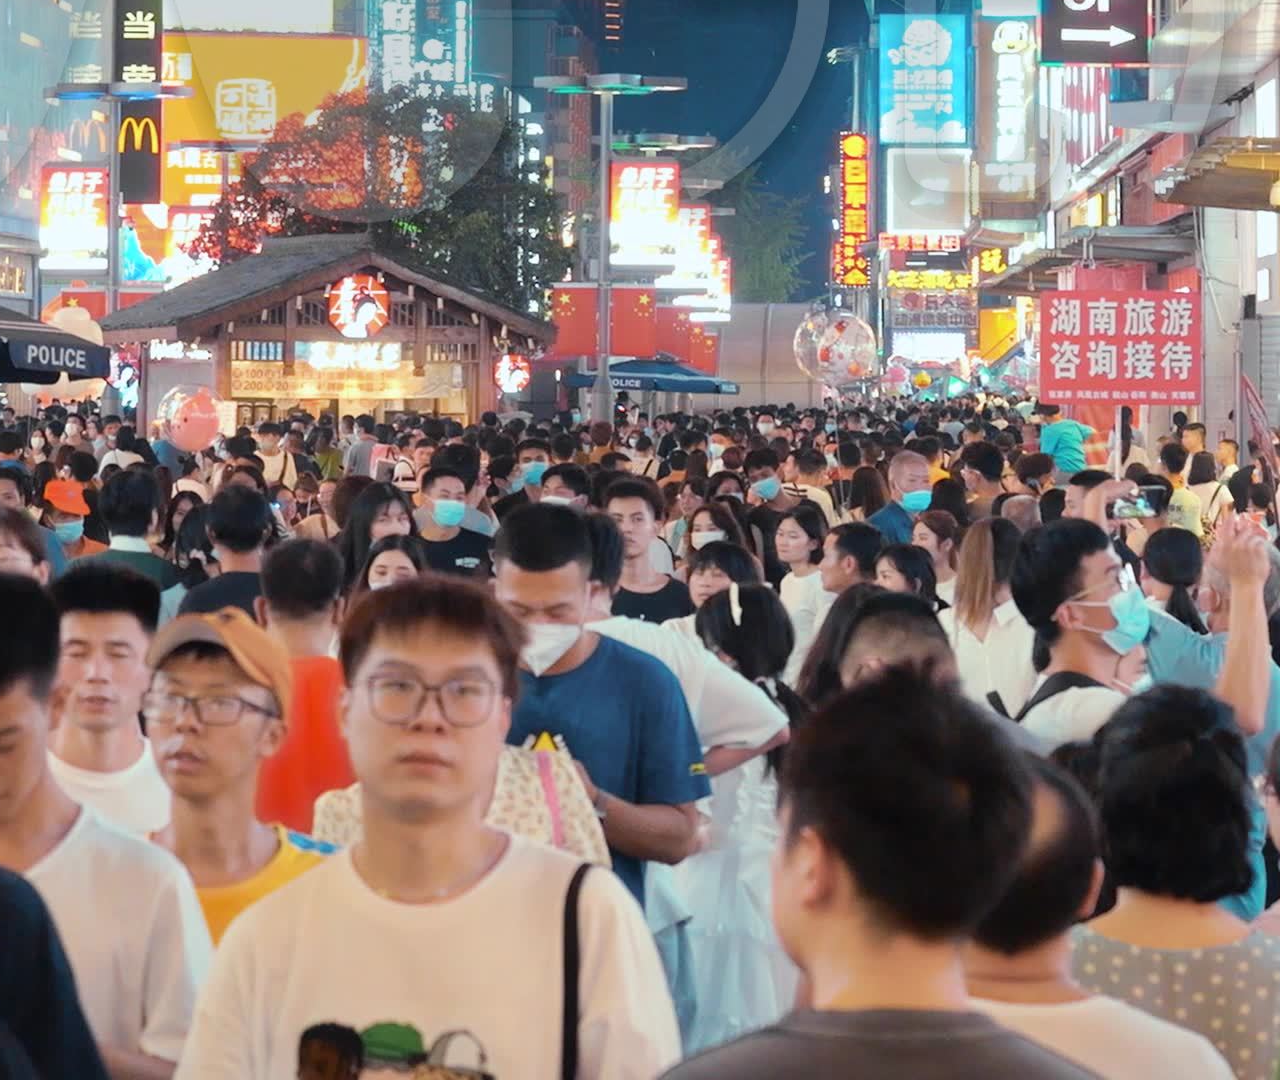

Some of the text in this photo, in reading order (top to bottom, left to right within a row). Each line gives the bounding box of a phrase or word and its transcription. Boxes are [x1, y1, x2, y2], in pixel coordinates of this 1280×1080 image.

[1049, 296, 1193, 337] 湖南旅游
[27, 344, 87, 369] POLICE
[1049, 340, 1193, 381] 咨询接待
